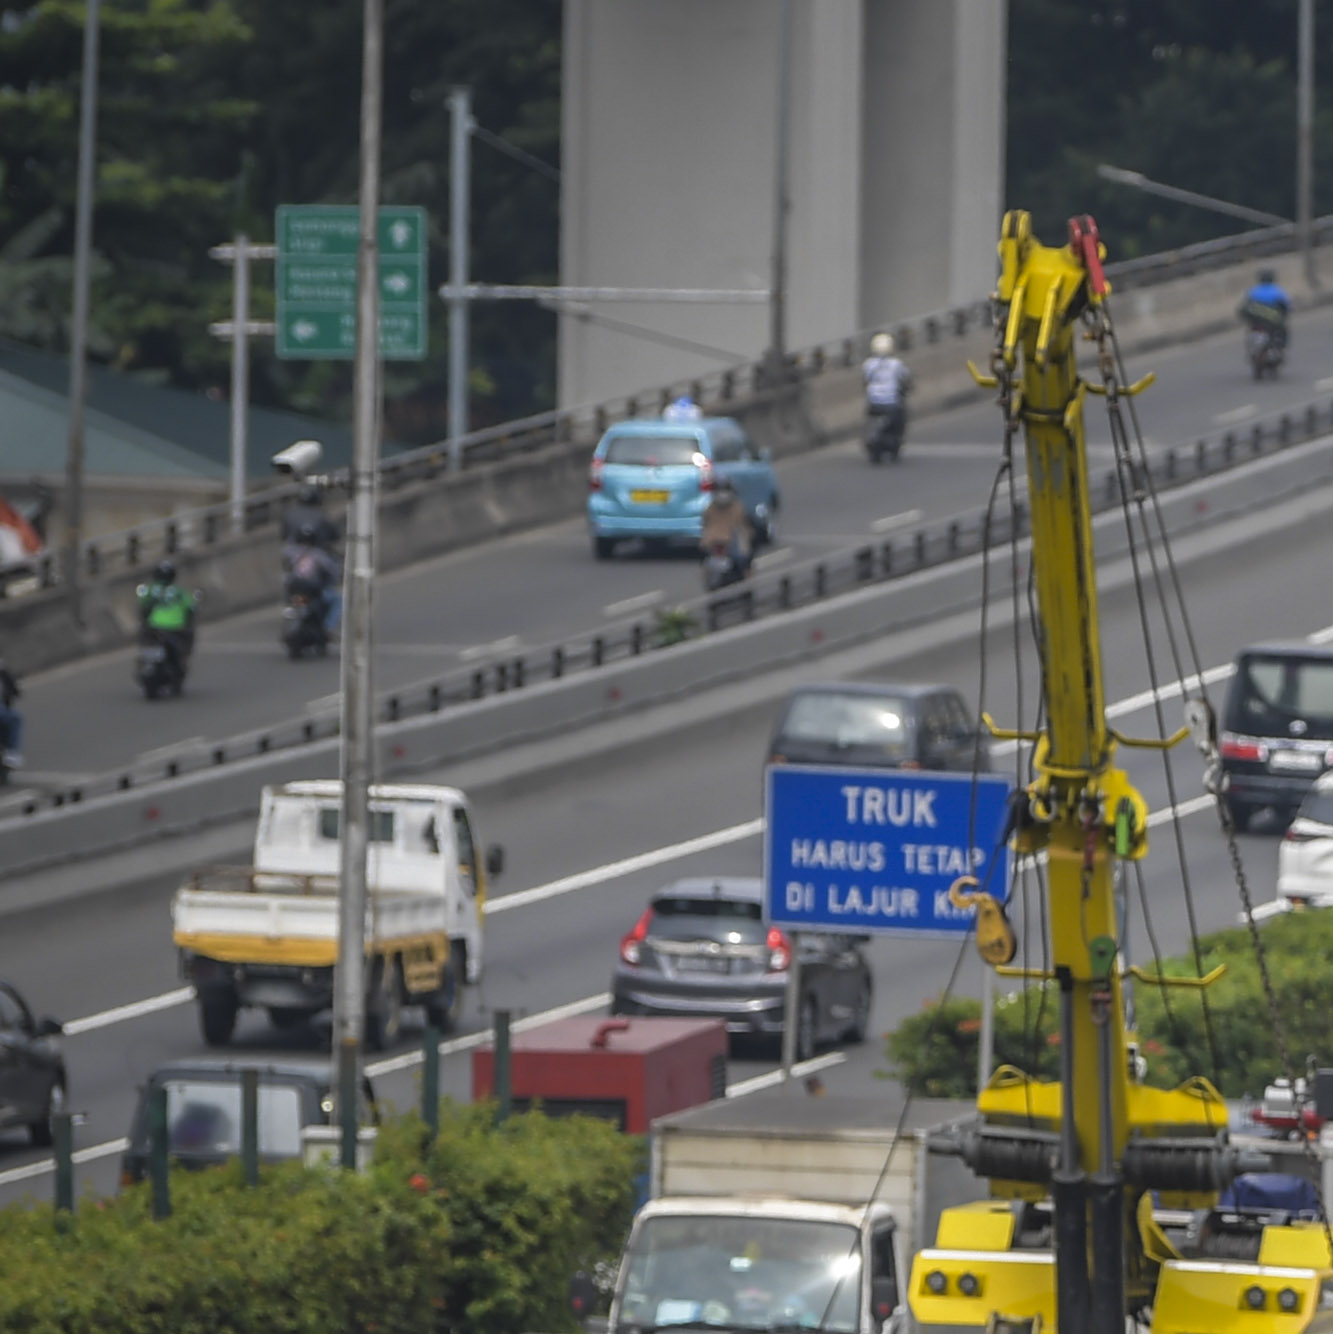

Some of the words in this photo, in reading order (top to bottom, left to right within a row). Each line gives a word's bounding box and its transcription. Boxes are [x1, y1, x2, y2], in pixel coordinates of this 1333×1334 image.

[841, 785, 938, 829] TRUK
[790, 838, 886, 873] HARUS
[901, 842, 986, 876] TETAP
[785, 881, 816, 913] DI
[827, 884, 919, 918] LAJUR
